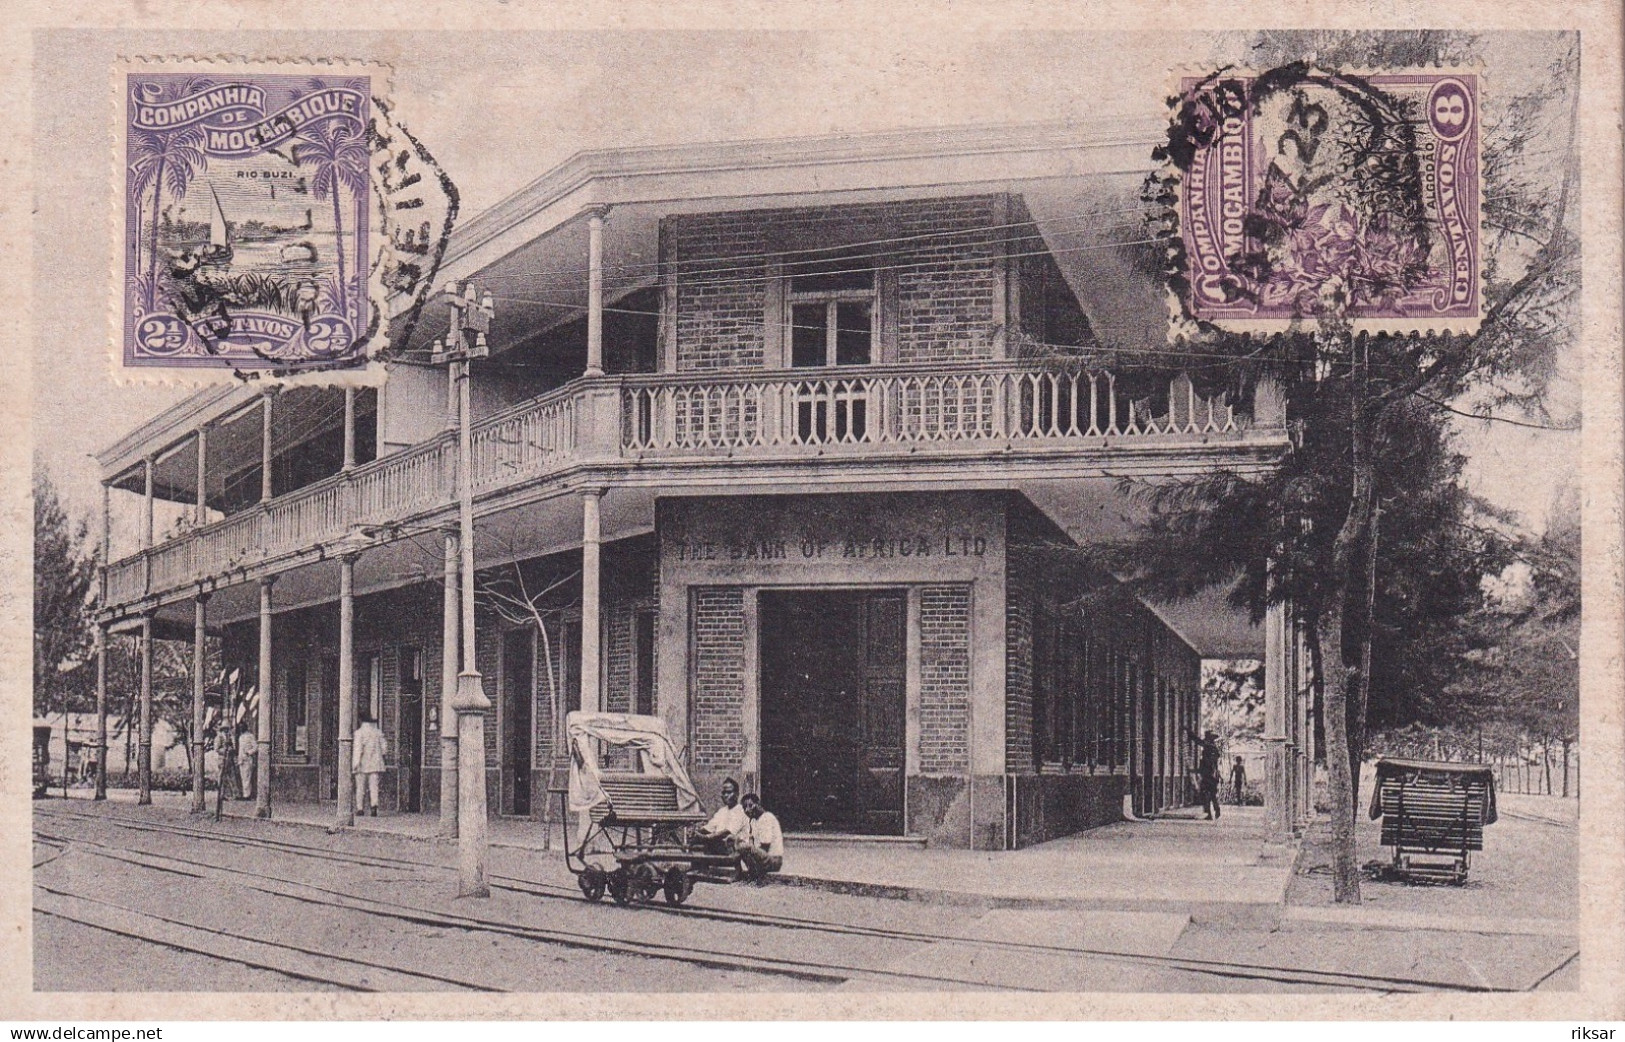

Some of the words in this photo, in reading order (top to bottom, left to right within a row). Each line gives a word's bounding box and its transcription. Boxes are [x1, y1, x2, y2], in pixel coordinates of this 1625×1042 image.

[140, 87, 262, 126] COMPANHIA
[210, 92, 357, 152] MOÇAMBIQUE
[221, 110, 248, 123] DE
[1435, 95, 1465, 125] 8
[236, 170, 258, 179] RIO
[1223, 83, 1248, 257] MOÇAMBIQ
[1423, 142, 1437, 210] ALGODÃO
[1438, 144, 1468, 301] CENTAVOS
[677, 541, 716, 561] THE
[729, 540, 788, 560] BANK
[801, 538, 828, 559] OF
[842, 536, 931, 559] AFRICA
[945, 535, 987, 557] LTD
